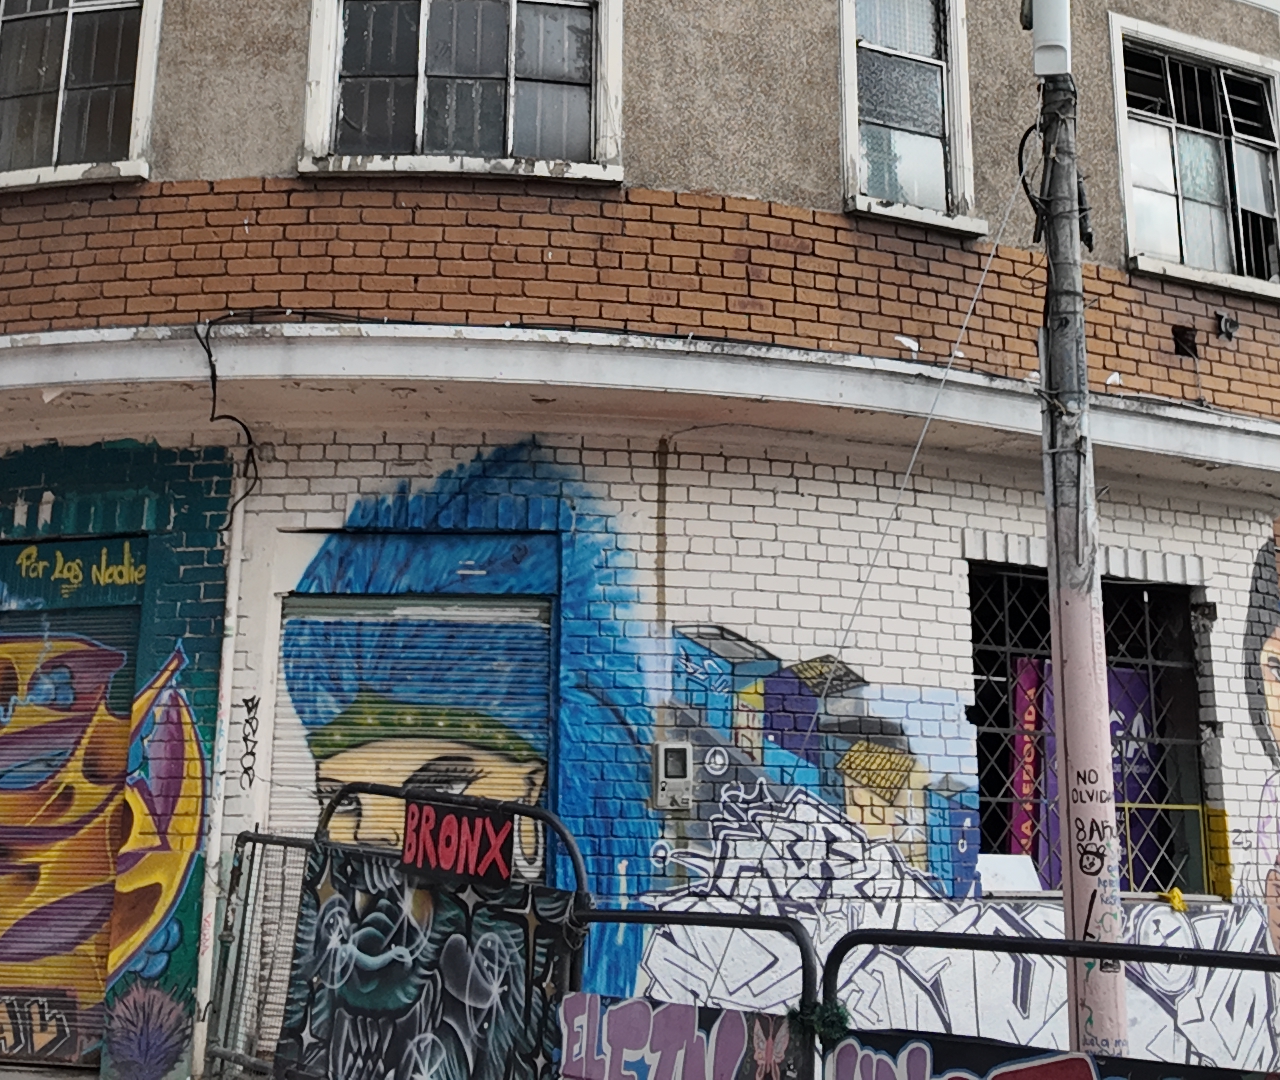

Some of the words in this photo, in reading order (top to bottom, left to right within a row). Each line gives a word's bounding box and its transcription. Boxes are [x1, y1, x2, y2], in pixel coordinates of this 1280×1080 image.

[16, 545, 50, 578] Por
[1076, 768, 1099, 786] NO
[403, 802, 513, 881] BRONX
